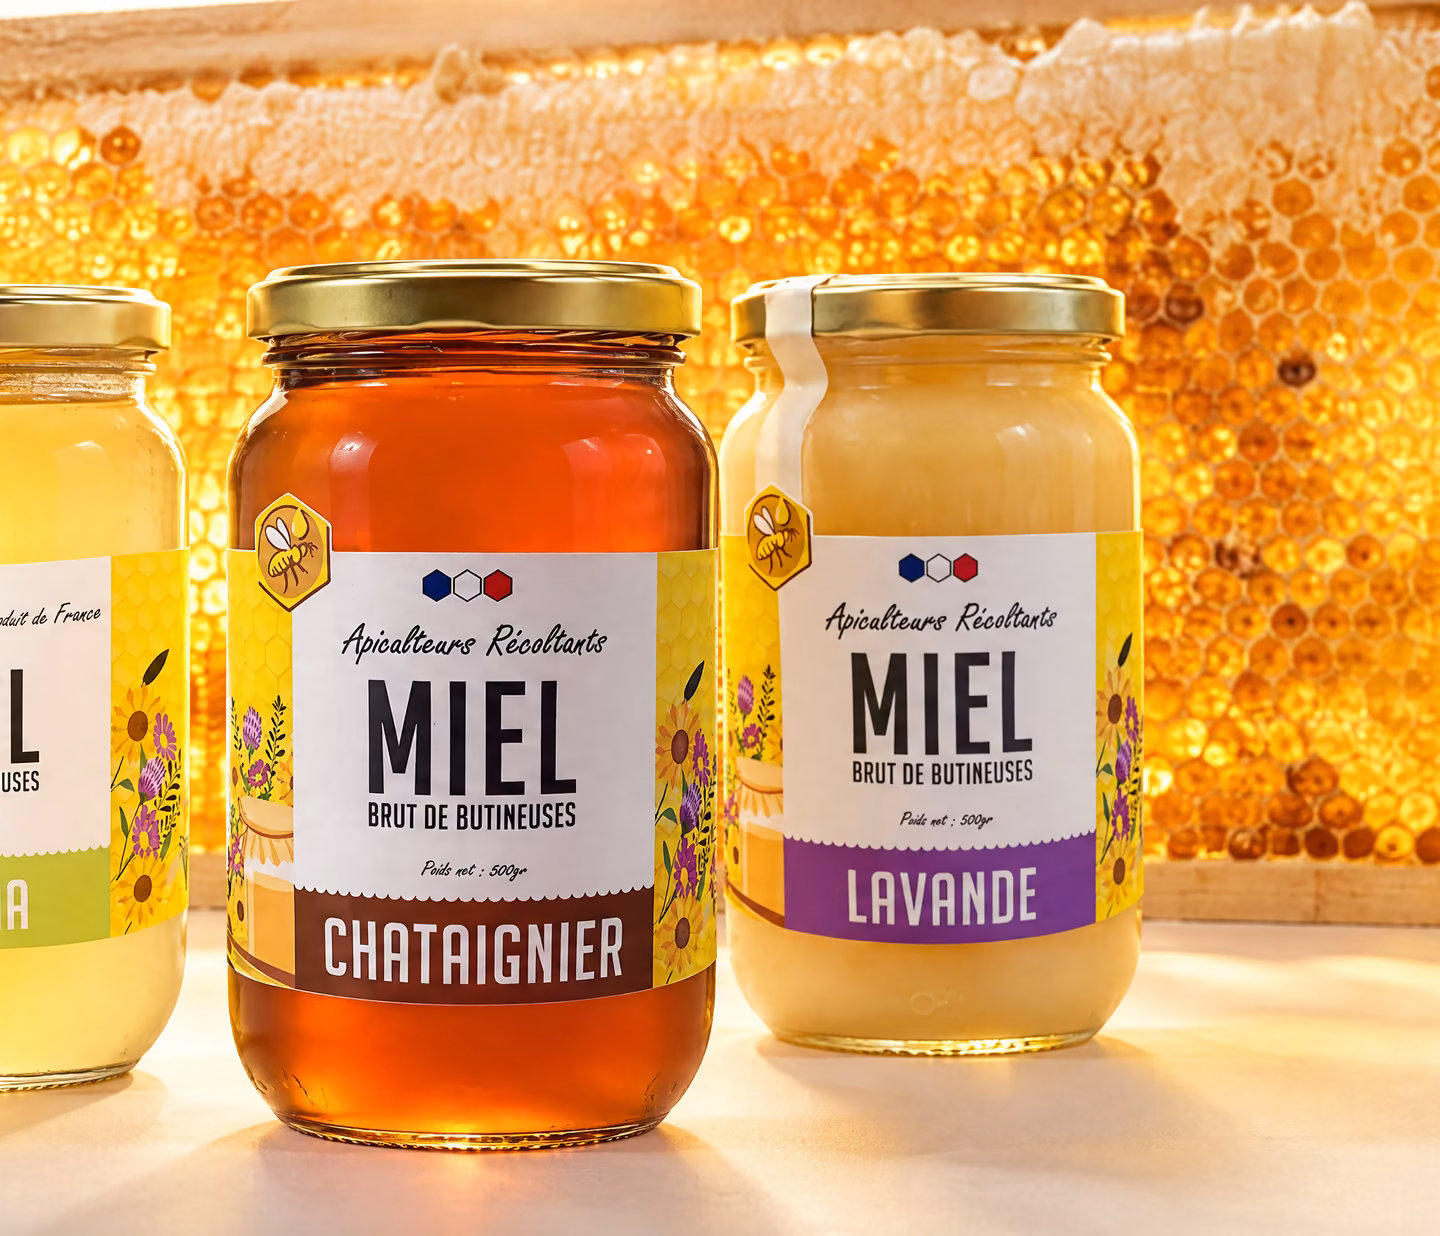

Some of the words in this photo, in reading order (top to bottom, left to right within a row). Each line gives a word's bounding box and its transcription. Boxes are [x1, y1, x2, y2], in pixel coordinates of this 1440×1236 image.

[32, 608, 47, 625] de
[54, 602, 101, 623] France
[955, 602, 1057, 631] Récoltants
[486, 624, 607, 656] Récoltants
[851, 651, 1032, 755] MIEL
[368, 680, 576, 795] MIEL
[853, 761, 896, 784] BRUT
[903, 763, 924, 784] DE
[932, 759, 1032, 784] BUTINEUSES
[369, 802, 417, 829] BRUT
[425, 805, 448, 830] DE
[457, 802, 575, 830] BUTINEUSES
[900, 812, 927, 825] Poids
[931, 815, 948, 826] net
[960, 814, 993, 829] 500gr
[421, 860, 452, 876] Poids
[455, 864, 476, 877] net
[489, 864, 527, 882] 500gr
[848, 867, 1036, 925] LAVANDE
[325, 918, 622, 984] CHATAIGNIER
